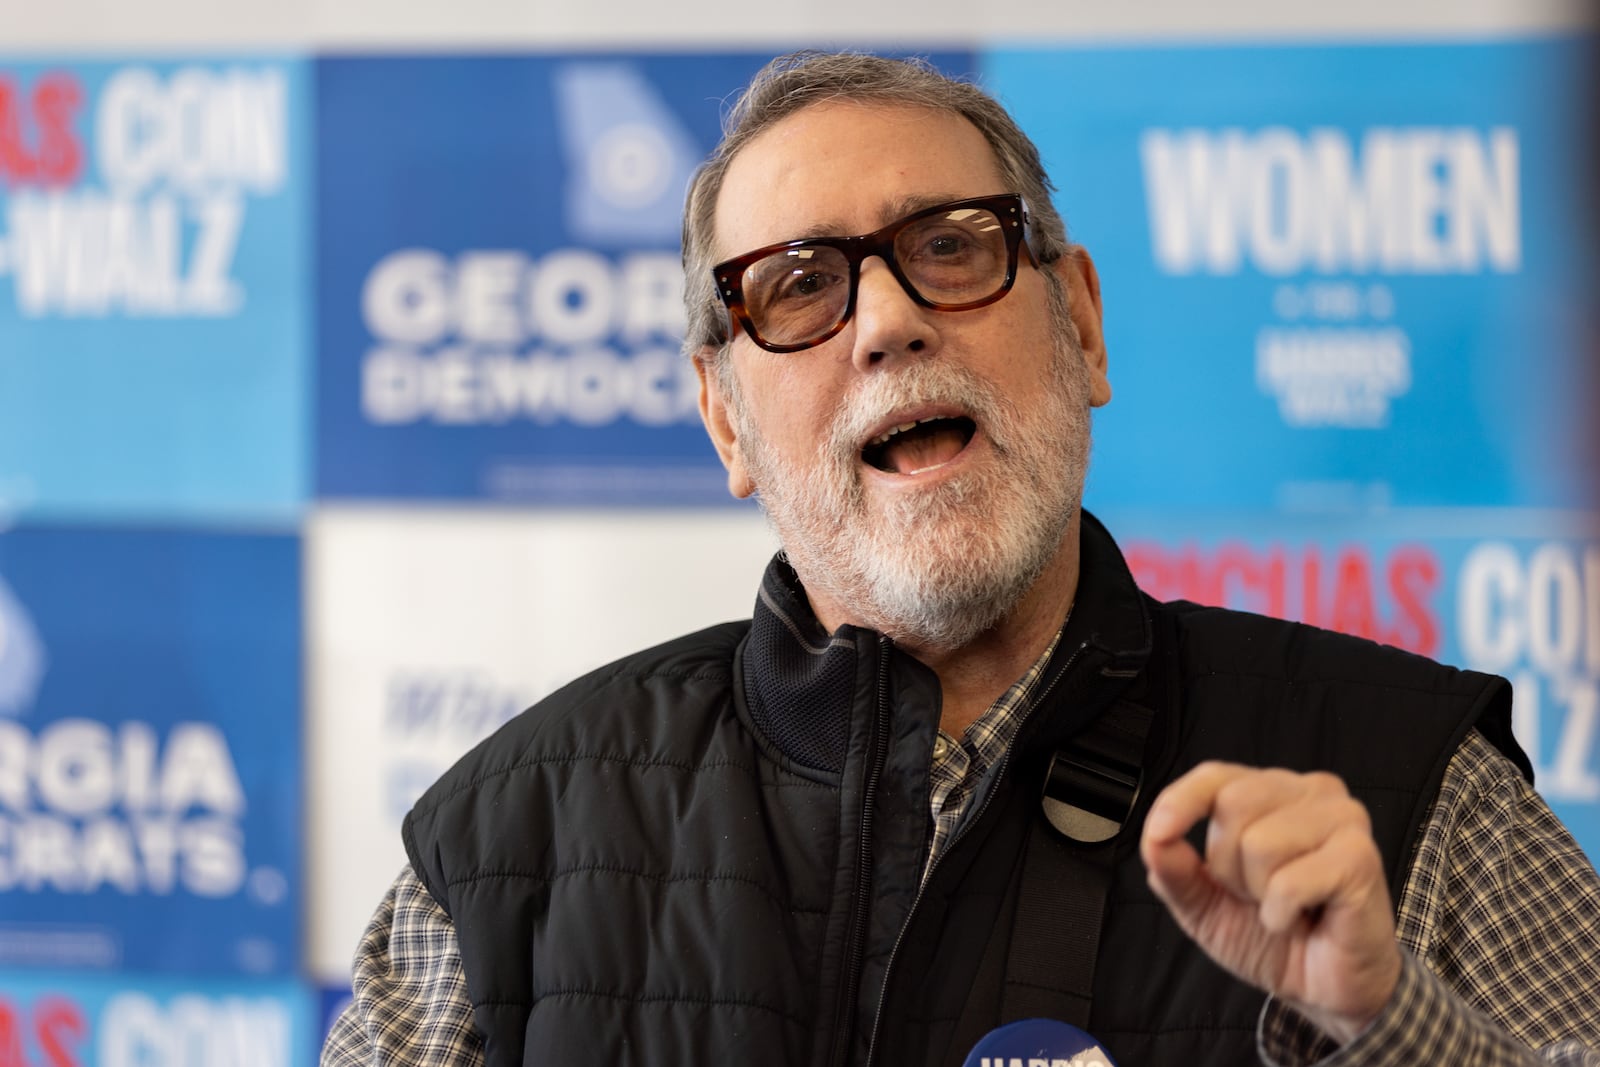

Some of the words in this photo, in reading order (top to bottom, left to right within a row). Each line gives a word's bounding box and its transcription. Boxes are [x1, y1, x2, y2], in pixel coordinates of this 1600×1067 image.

[97, 68, 288, 194] CON
[1143, 127, 1521, 275] WOMEN
[361, 347, 703, 425] DEMOC
[0, 815, 246, 896] RATS
